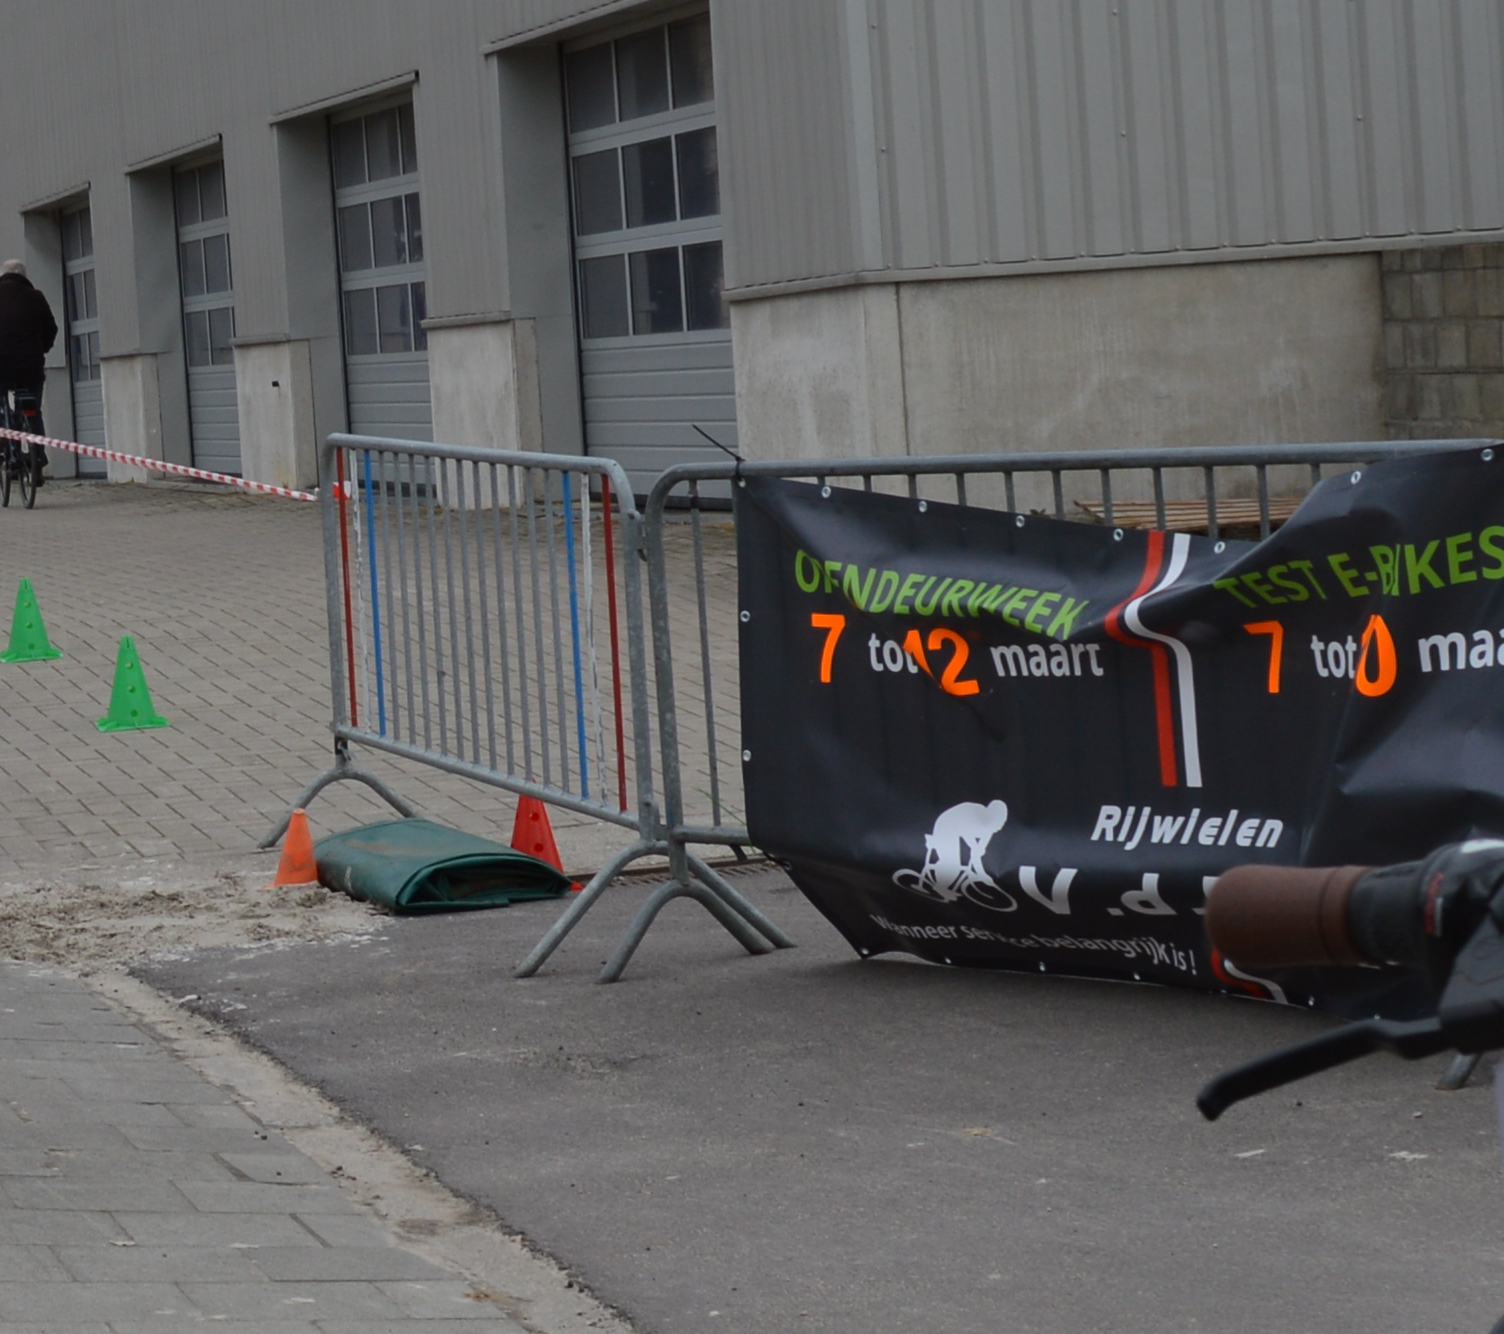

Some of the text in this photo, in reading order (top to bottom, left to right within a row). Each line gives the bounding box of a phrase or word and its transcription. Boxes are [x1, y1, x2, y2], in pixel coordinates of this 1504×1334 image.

[1212, 560, 1327, 608] TEST
[811, 613, 1104, 696] 7 tot 12 maart
[1243, 620, 1283, 694] 7
[1311, 635, 1357, 679] tot
[1091, 805, 1284, 851] Rijwielen
[869, 914, 958, 939] Wanneer
[1030, 934, 1170, 965] belangrijk
